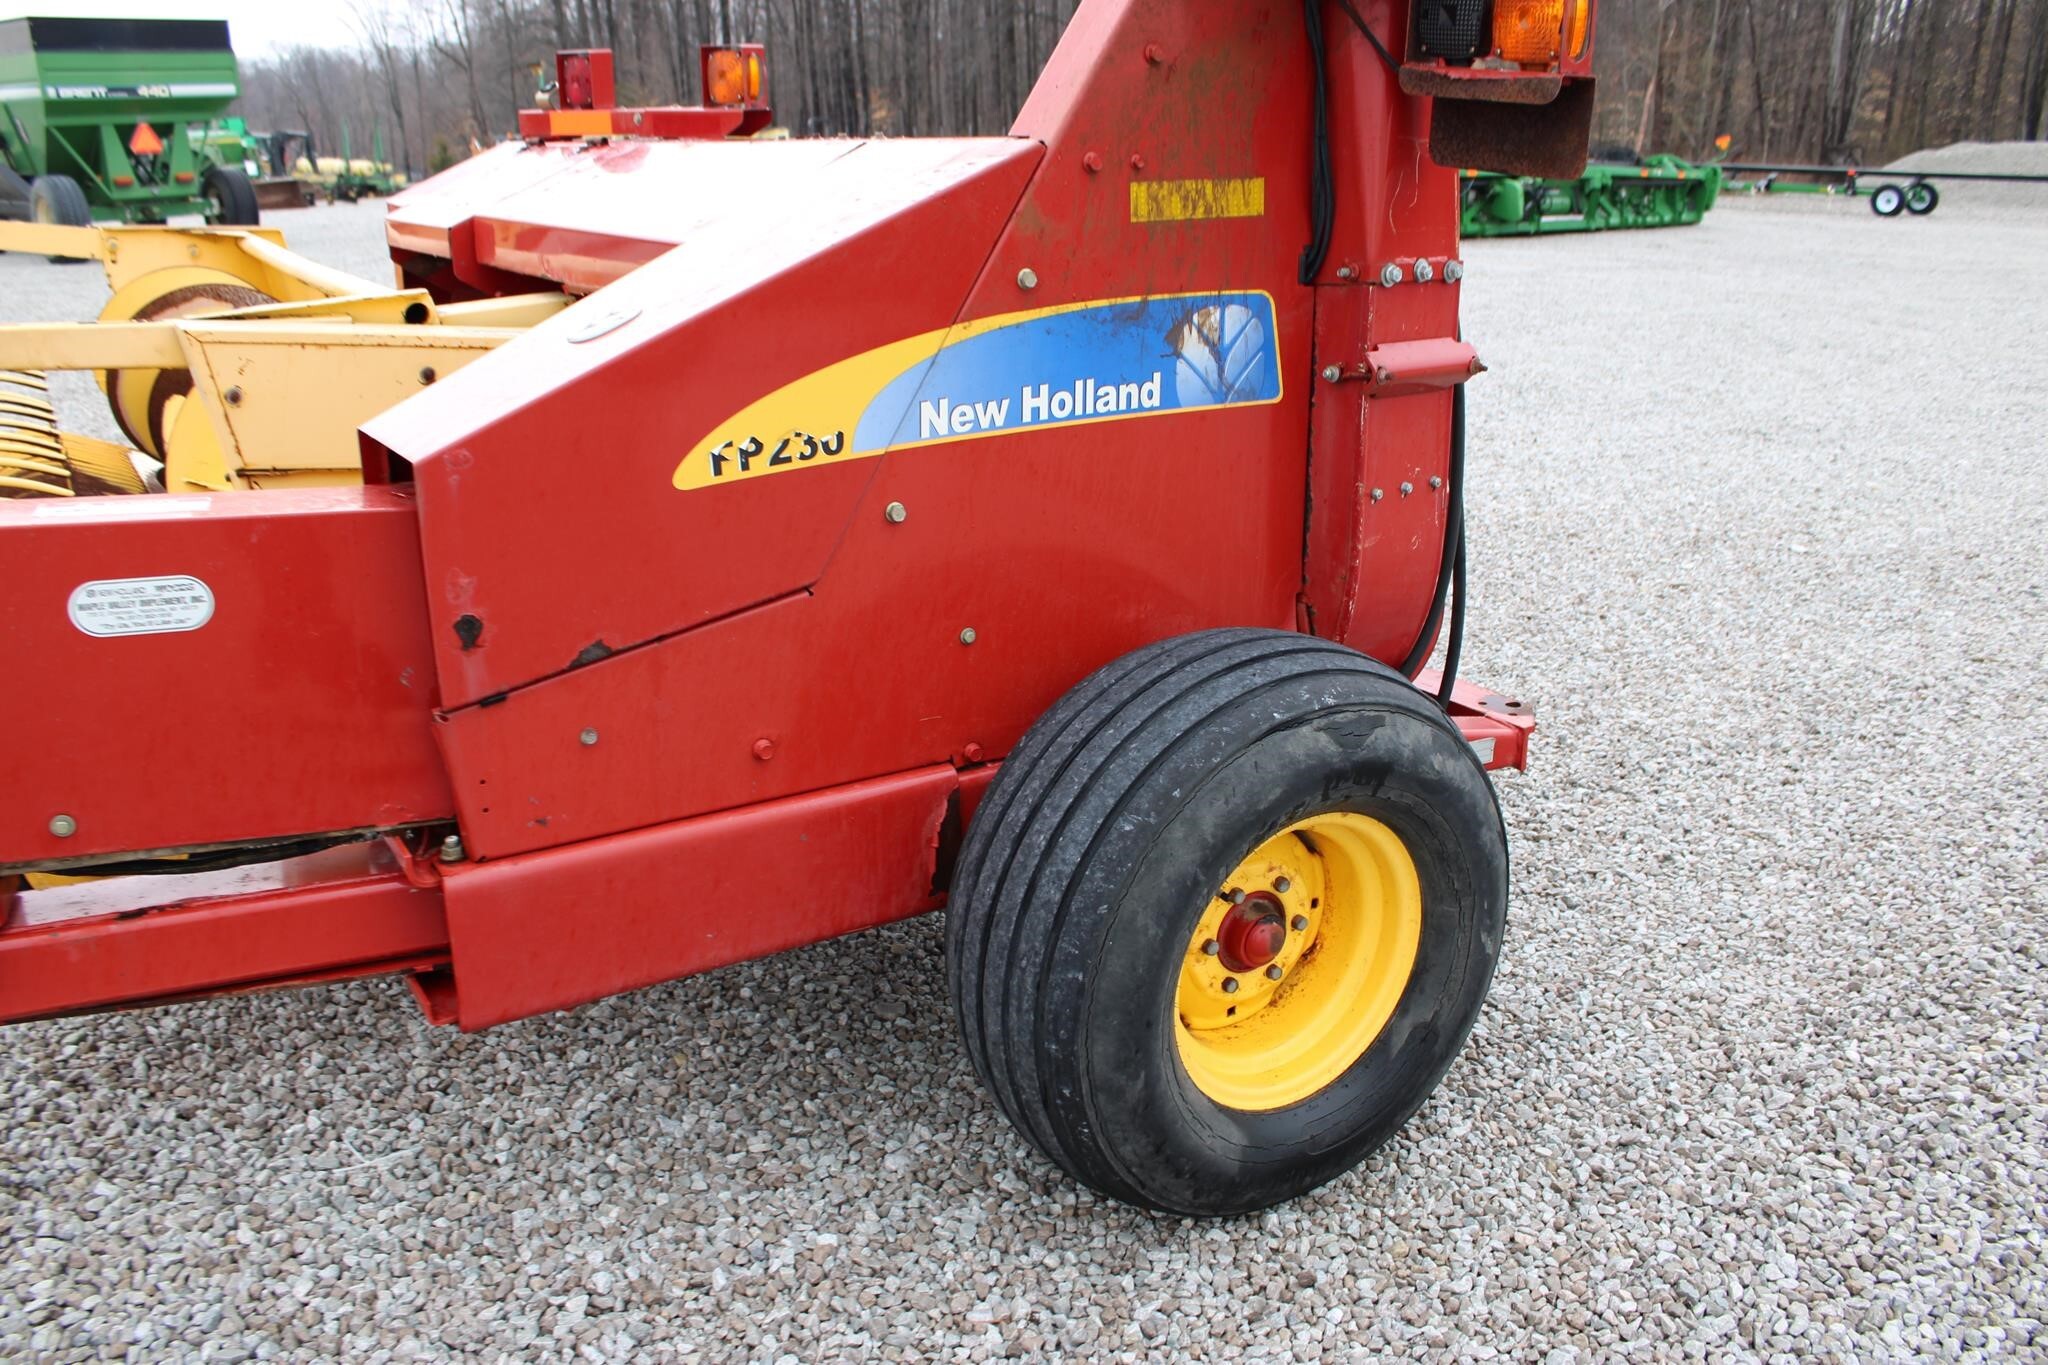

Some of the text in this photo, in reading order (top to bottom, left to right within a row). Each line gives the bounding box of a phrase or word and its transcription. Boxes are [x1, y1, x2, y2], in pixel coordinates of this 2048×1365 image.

[137, 84, 169, 98] 440
[919, 372, 1162, 438] New Holland
